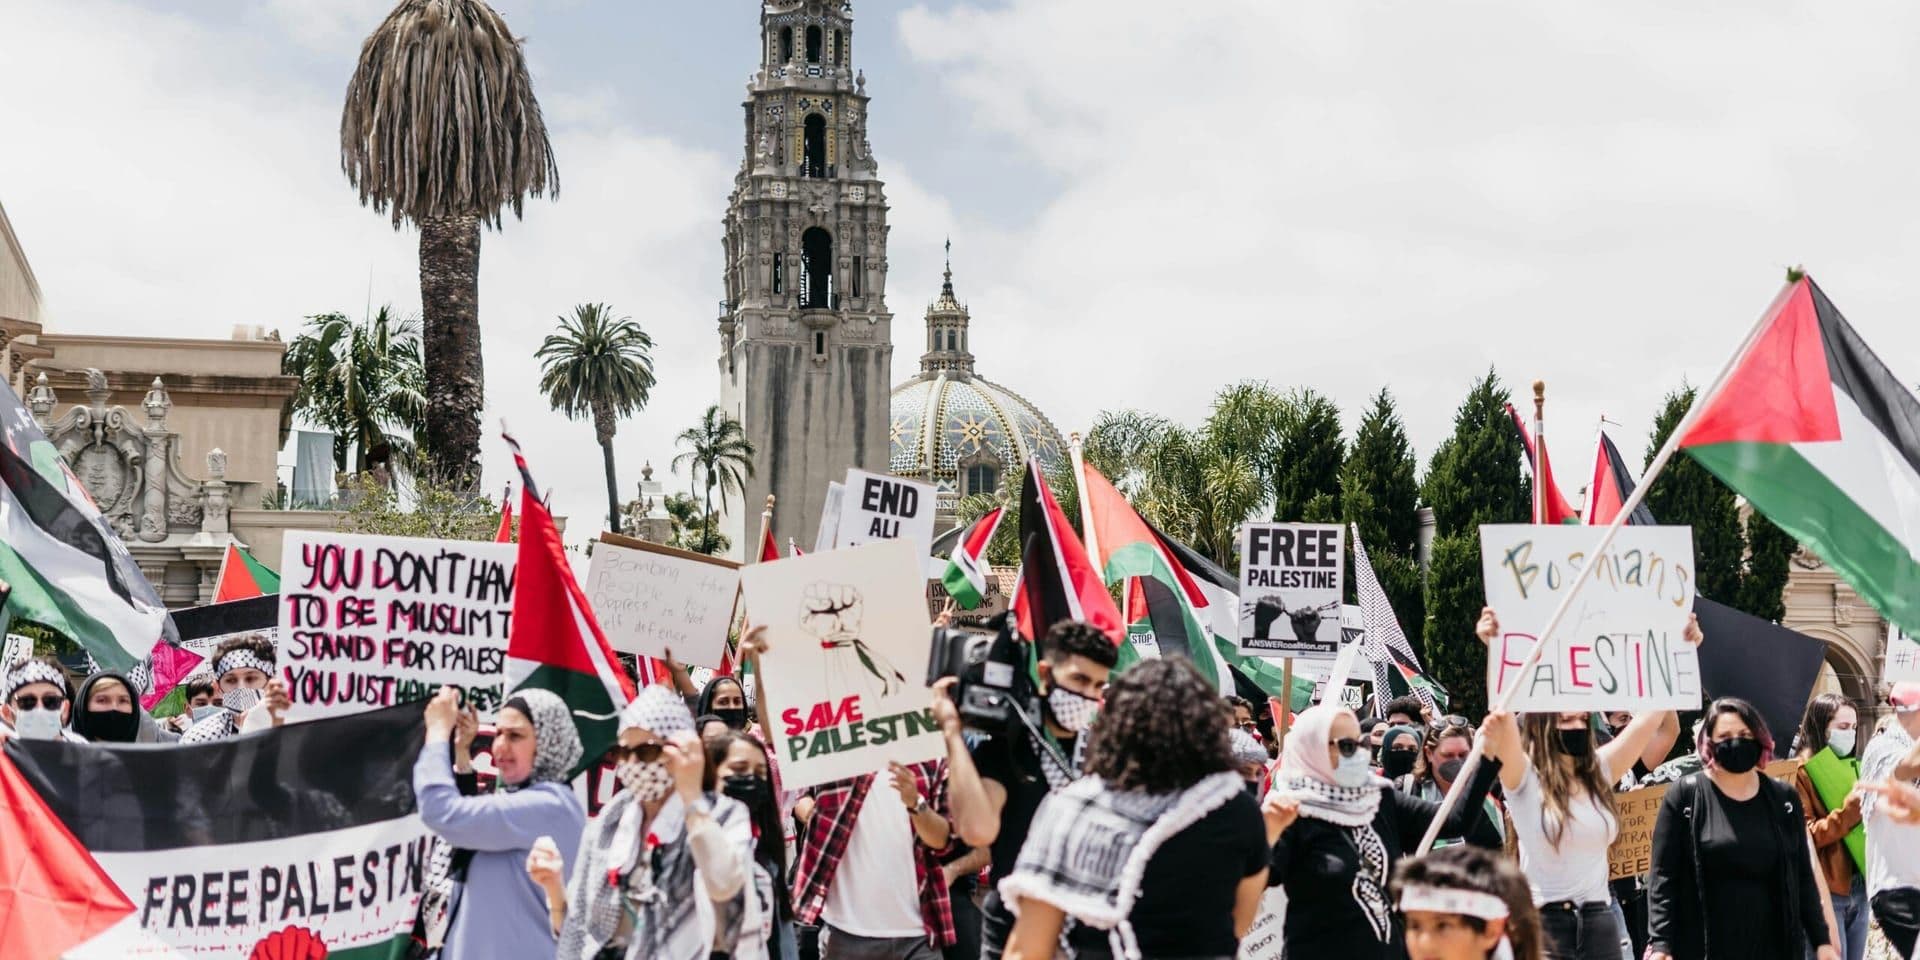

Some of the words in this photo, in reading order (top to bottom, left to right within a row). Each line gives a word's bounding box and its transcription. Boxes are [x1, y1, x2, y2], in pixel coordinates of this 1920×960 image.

[861, 477, 918, 519] END
[1249, 527, 1338, 568] FREE
[301, 543, 364, 594] YOU
[372, 547, 466, 595] DON'T
[466, 557, 517, 604] HAV
[1247, 568, 1337, 589] PALESTINE
[286, 593, 328, 629] TO
[336, 595, 378, 630] BE
[388, 599, 493, 638] MUSLIM
[497, 609, 512, 640] T
[8, 637, 19, 656] 73
[185, 639, 205, 649] FREE
[287, 630, 377, 662] STAND
[383, 638, 435, 672] FOR
[441, 644, 507, 675] PALEST
[1132, 634, 1153, 644] STOP
[1497, 629, 1697, 697] PALESTINE
[284, 665, 339, 707] YOU
[338, 672, 395, 708] JUST
[782, 694, 863, 737] SAVE
[1608, 857, 1649, 877] REE
[141, 869, 249, 929] FREE
